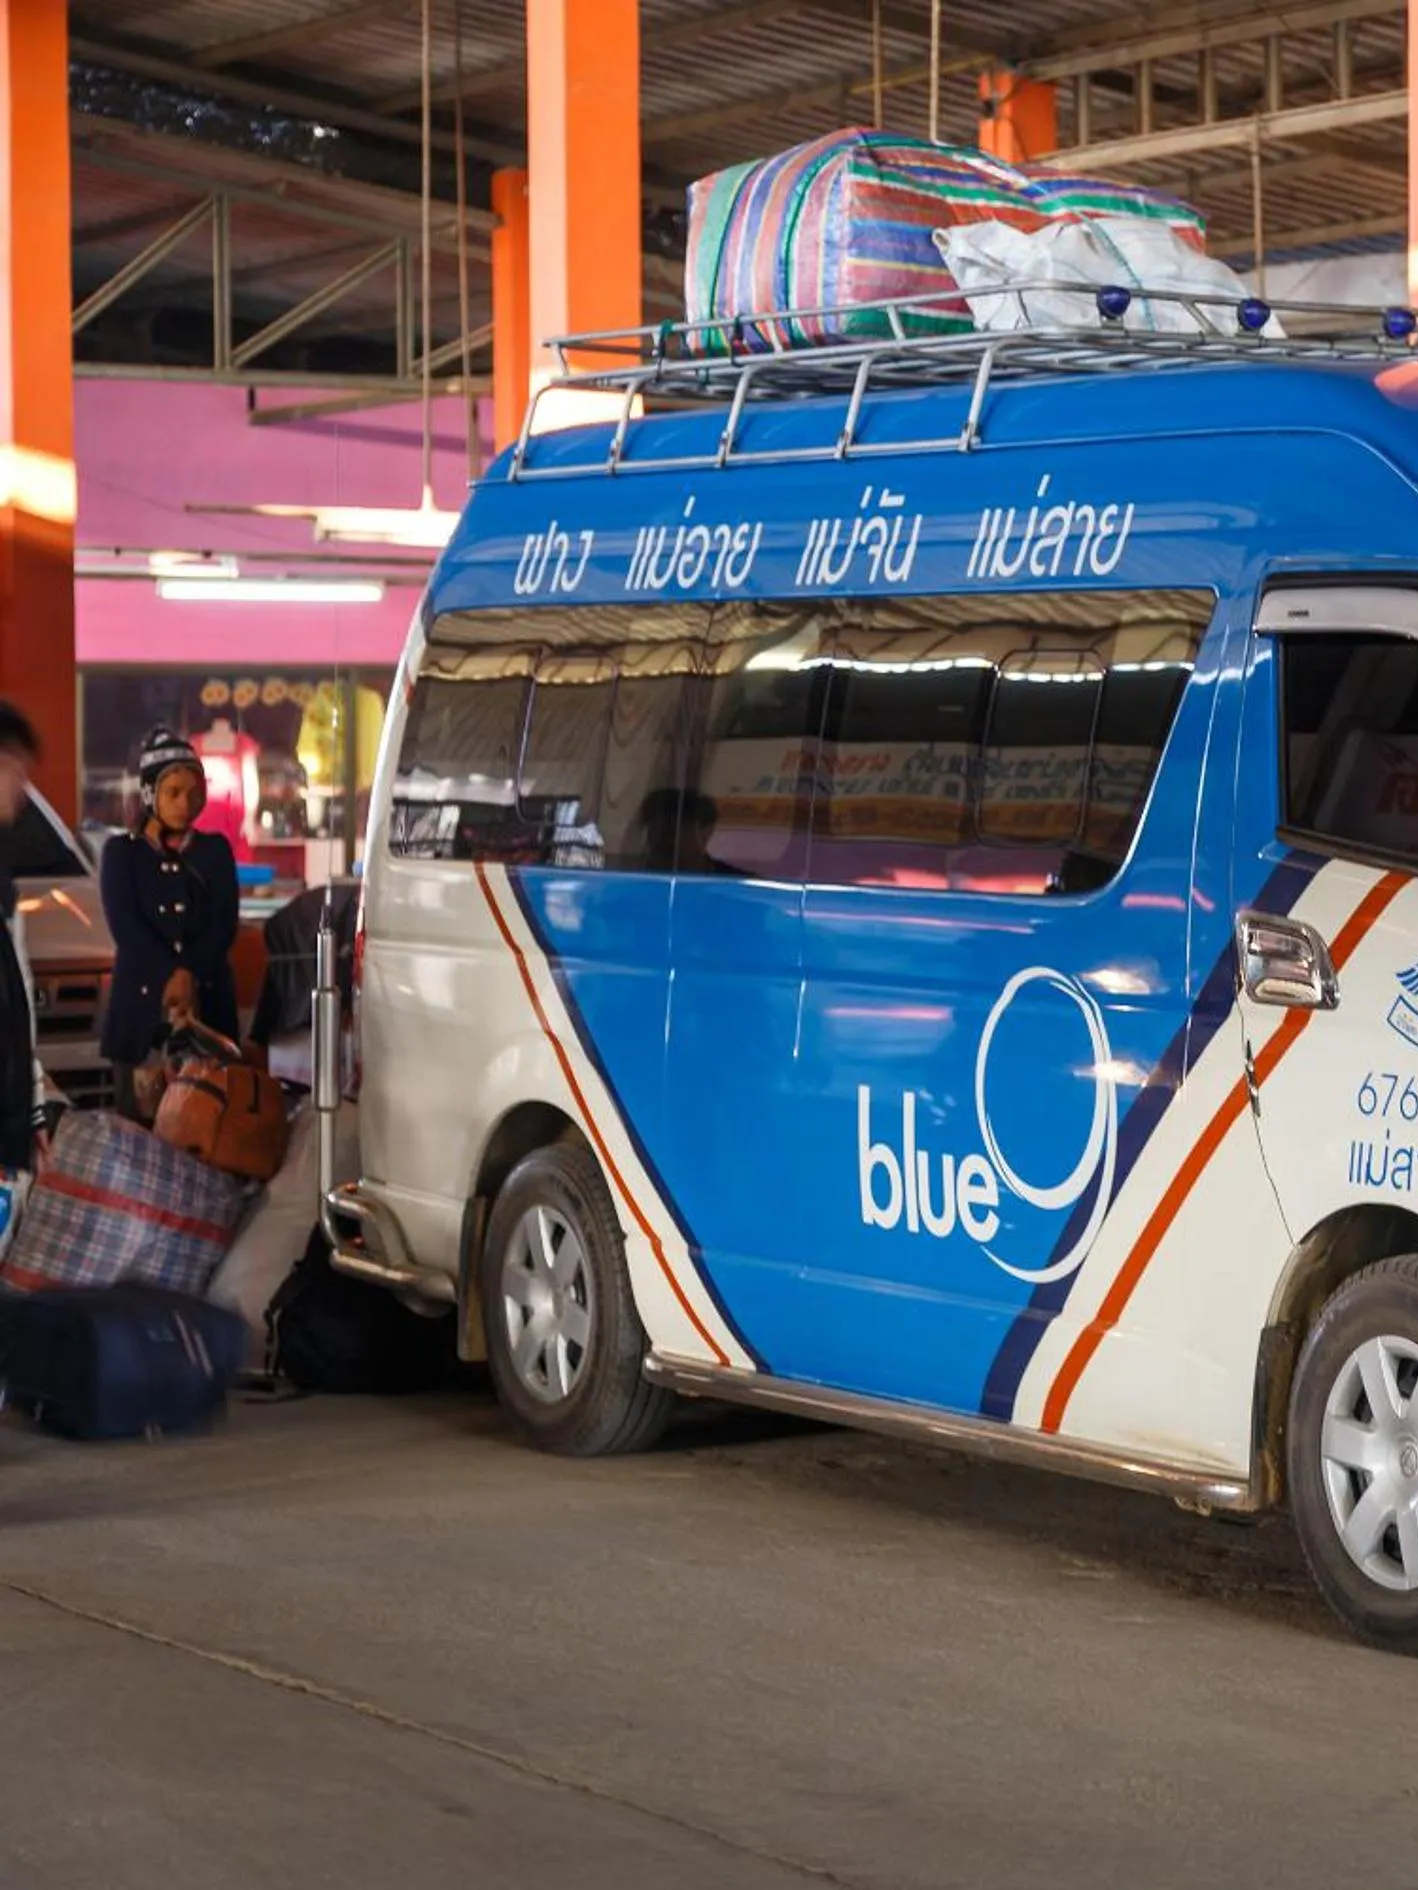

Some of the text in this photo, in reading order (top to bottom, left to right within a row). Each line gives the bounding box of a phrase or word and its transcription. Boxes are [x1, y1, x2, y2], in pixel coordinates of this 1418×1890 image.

[514, 474, 1135, 596] ฝาง แม่อาย แม่จัน แม่สาย
